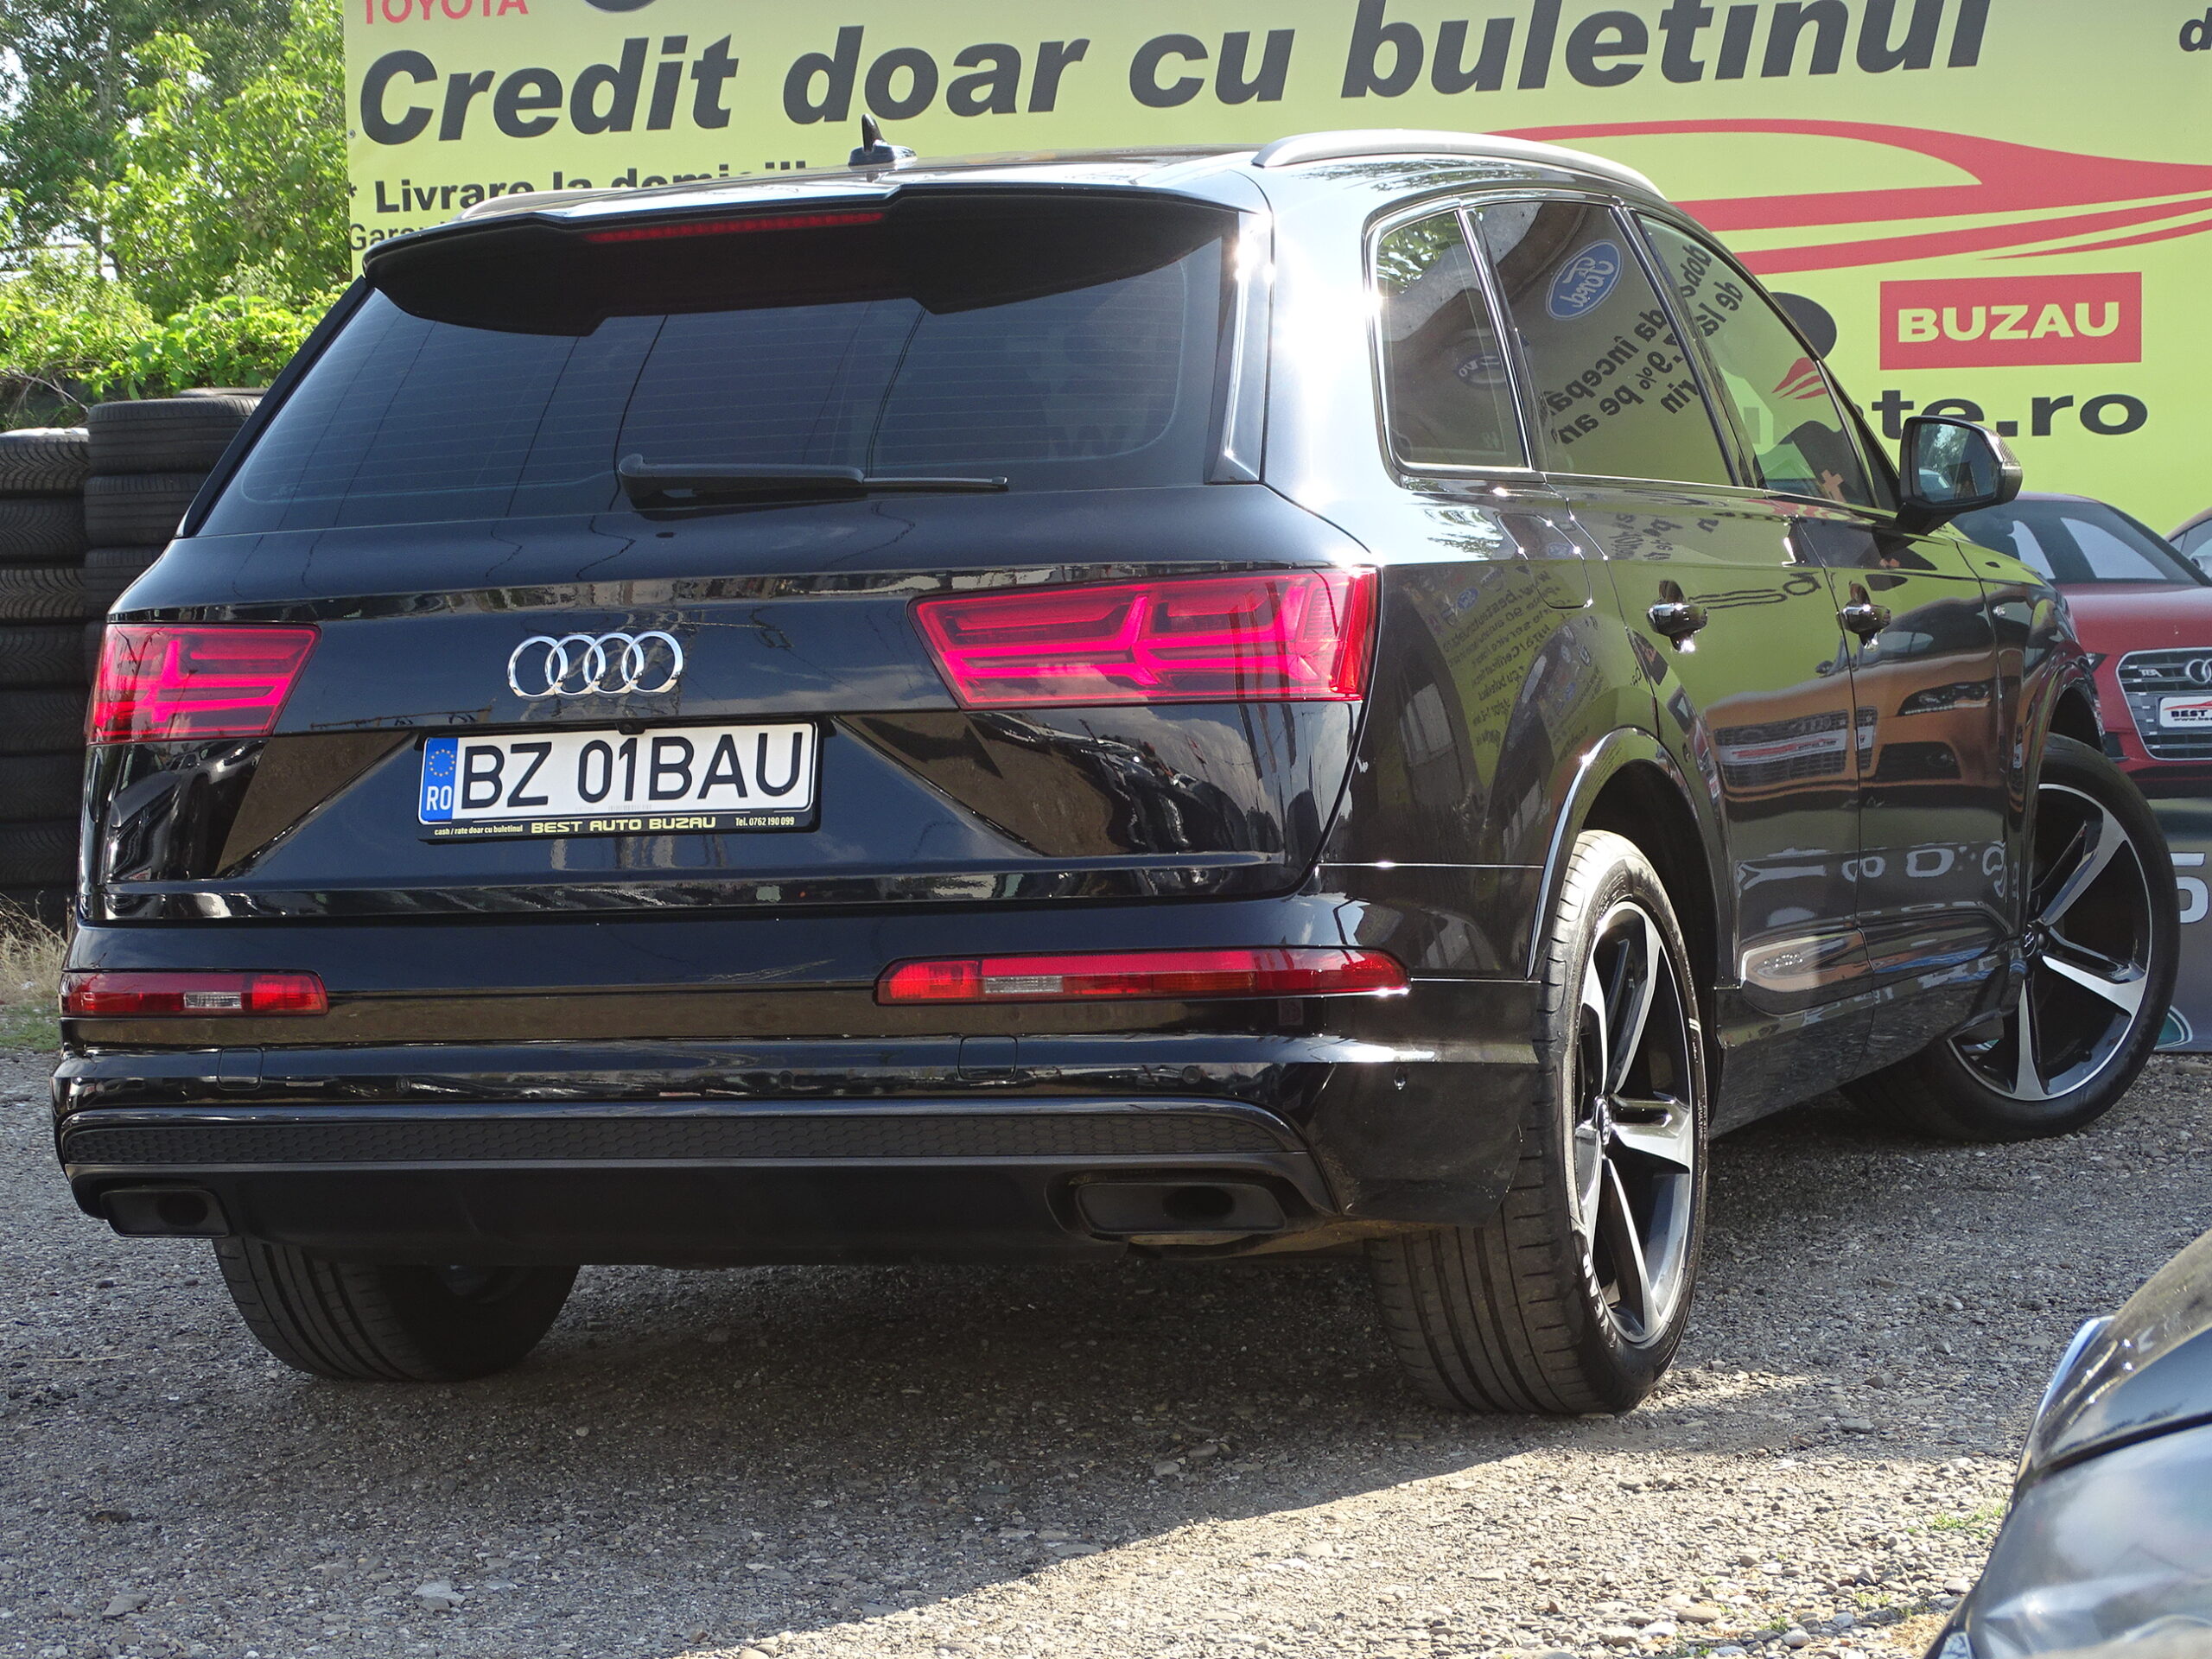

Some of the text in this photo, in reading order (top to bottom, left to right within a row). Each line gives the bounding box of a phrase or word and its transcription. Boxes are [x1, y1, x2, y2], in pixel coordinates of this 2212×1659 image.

[360, 0, 1991, 146] Credit doar cu buletinul
[1897, 301, 2120, 343] BUZAU
[425, 785, 452, 811] RO
[461, 741, 552, 810] BZ
[435, 826, 449, 836] cash
[454, 825, 467, 835] rate
[468, 825, 483, 835] doar
[493, 824, 523, 834] buletinul
[531, 821, 583, 834] BEST
[589, 818, 642, 831] AUTO
[649, 817, 716, 830] BUZAU
[735, 817, 748, 827] Tel.
[748, 817, 766, 827] 0762
[767, 817, 779, 826] 190
[780, 817, 795, 826] 099
